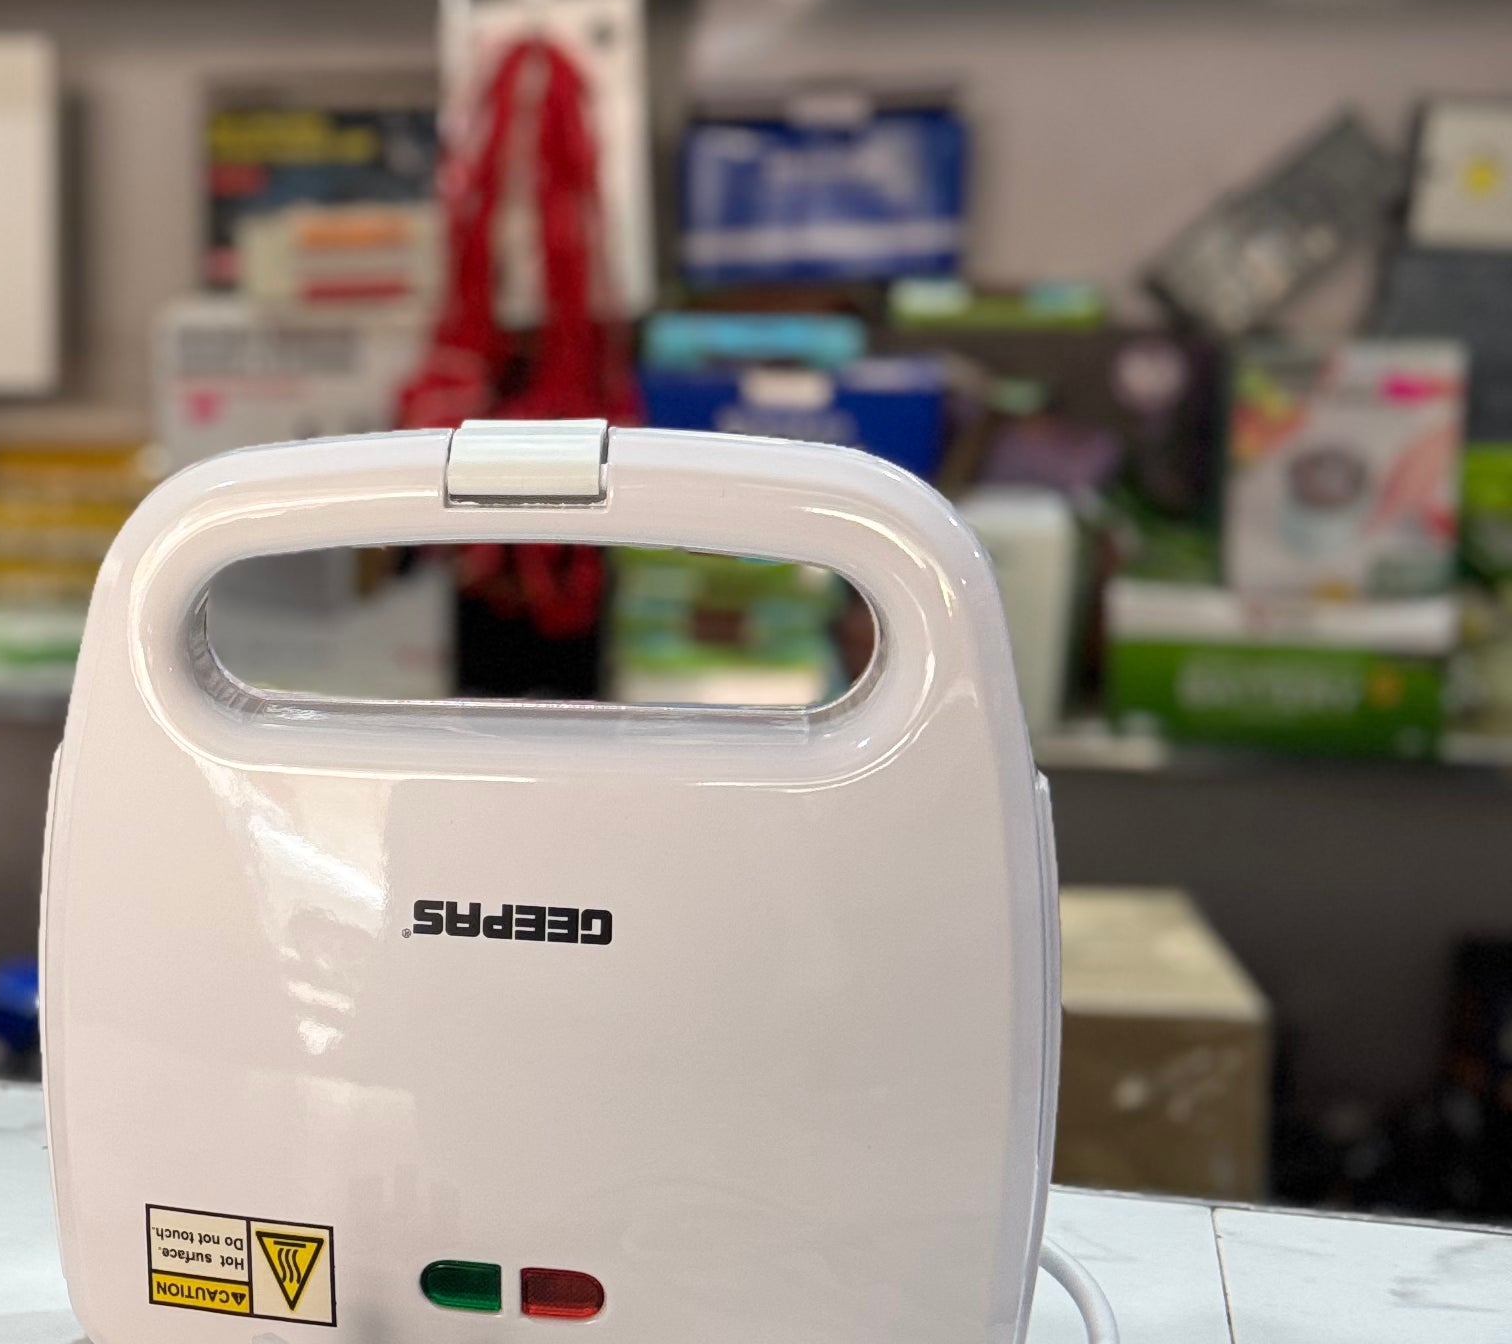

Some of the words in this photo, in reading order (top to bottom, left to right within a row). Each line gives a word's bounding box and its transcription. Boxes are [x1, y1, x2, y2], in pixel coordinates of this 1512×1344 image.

[151, 1226, 194, 1244] touch.
[197, 1232, 220, 1245] not
[224, 1237, 244, 1251] Do
[157, 1246, 212, 1264] surface.
[219, 1254, 245, 1270] Hot
[155, 1280, 230, 1304] CAUTION
